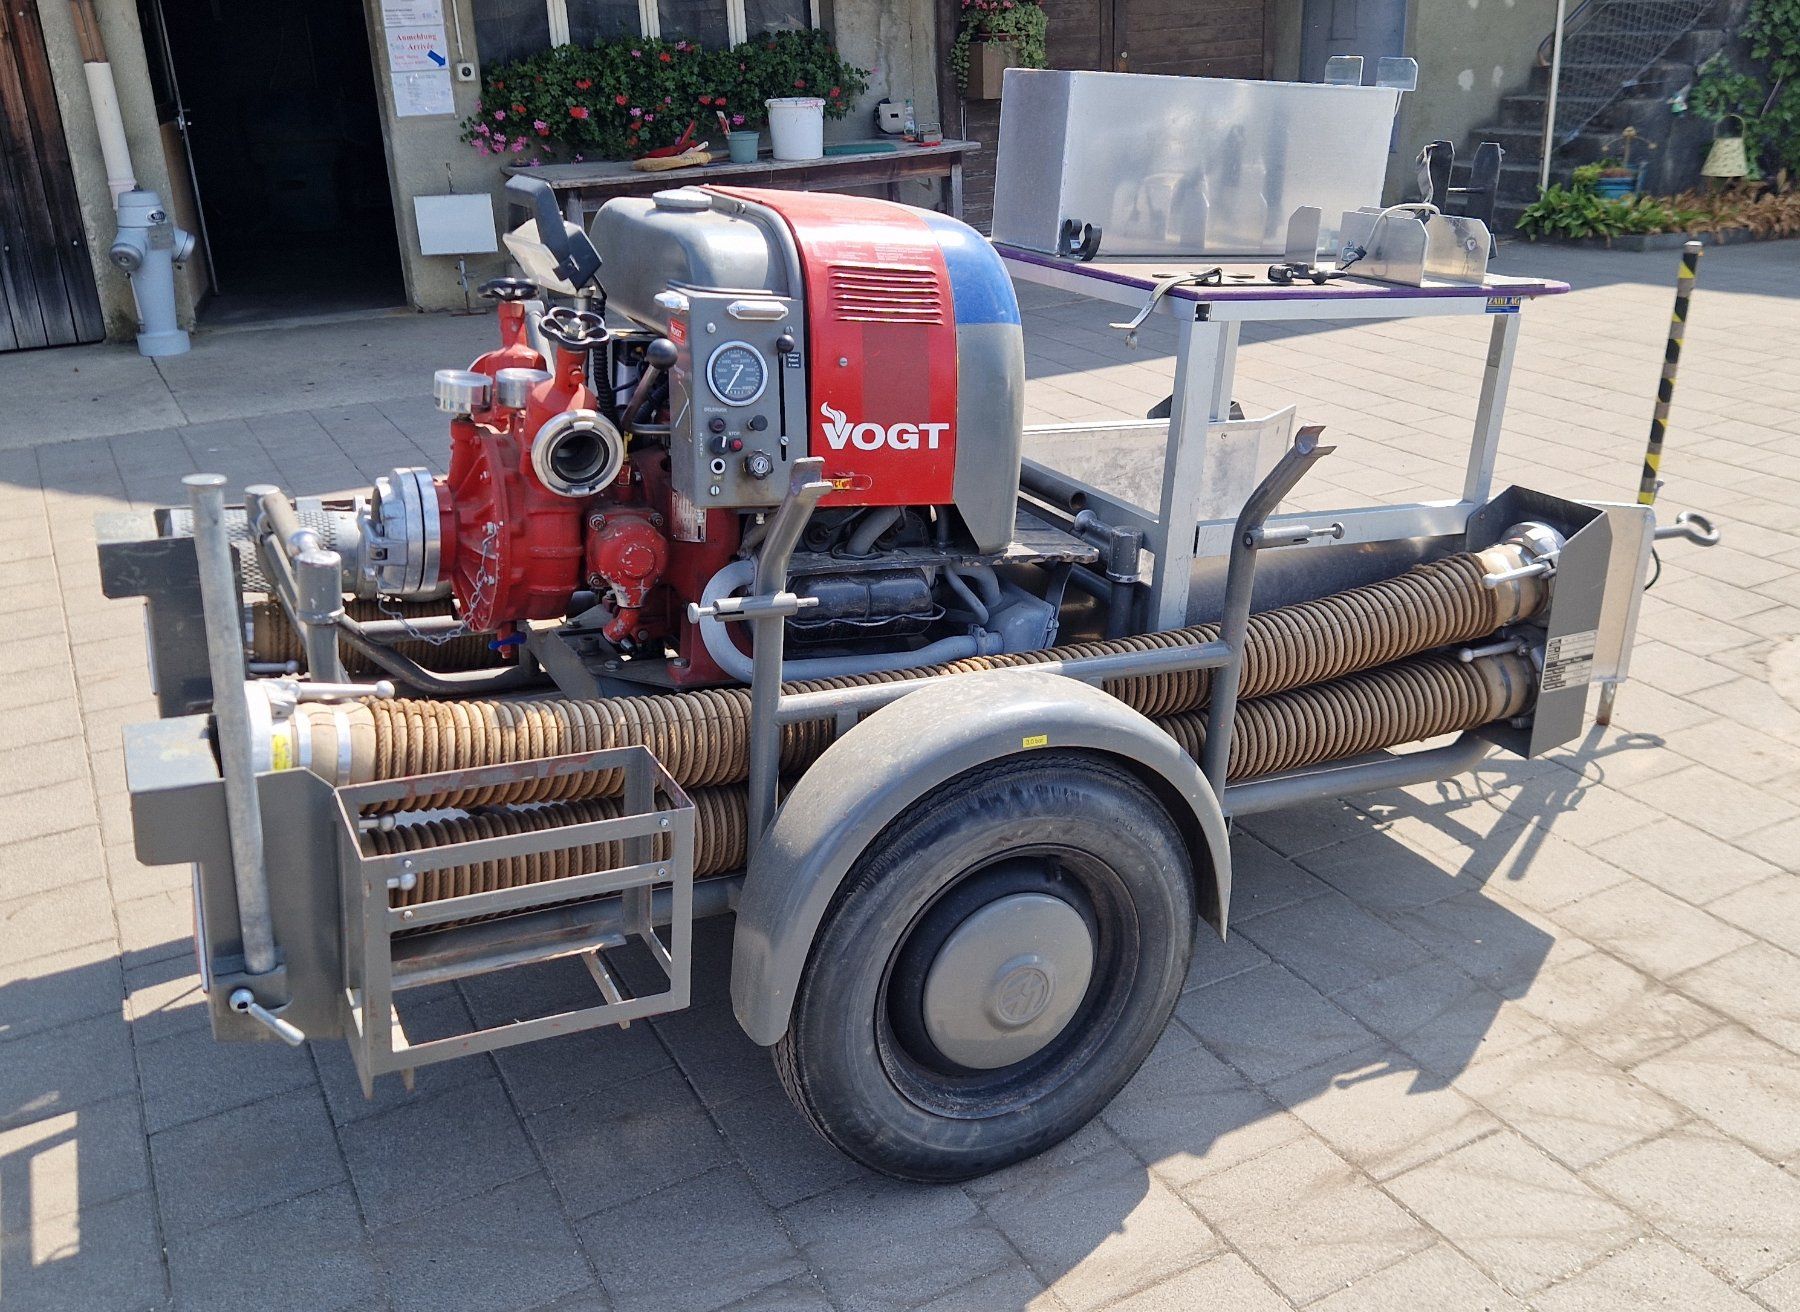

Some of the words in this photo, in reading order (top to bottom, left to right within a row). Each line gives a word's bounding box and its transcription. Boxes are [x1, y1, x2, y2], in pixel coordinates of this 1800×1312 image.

[397, 33, 437, 41] Anmeldung
[408, 43, 434, 51] Arrivée
[821, 422, 950, 451] VOGT
